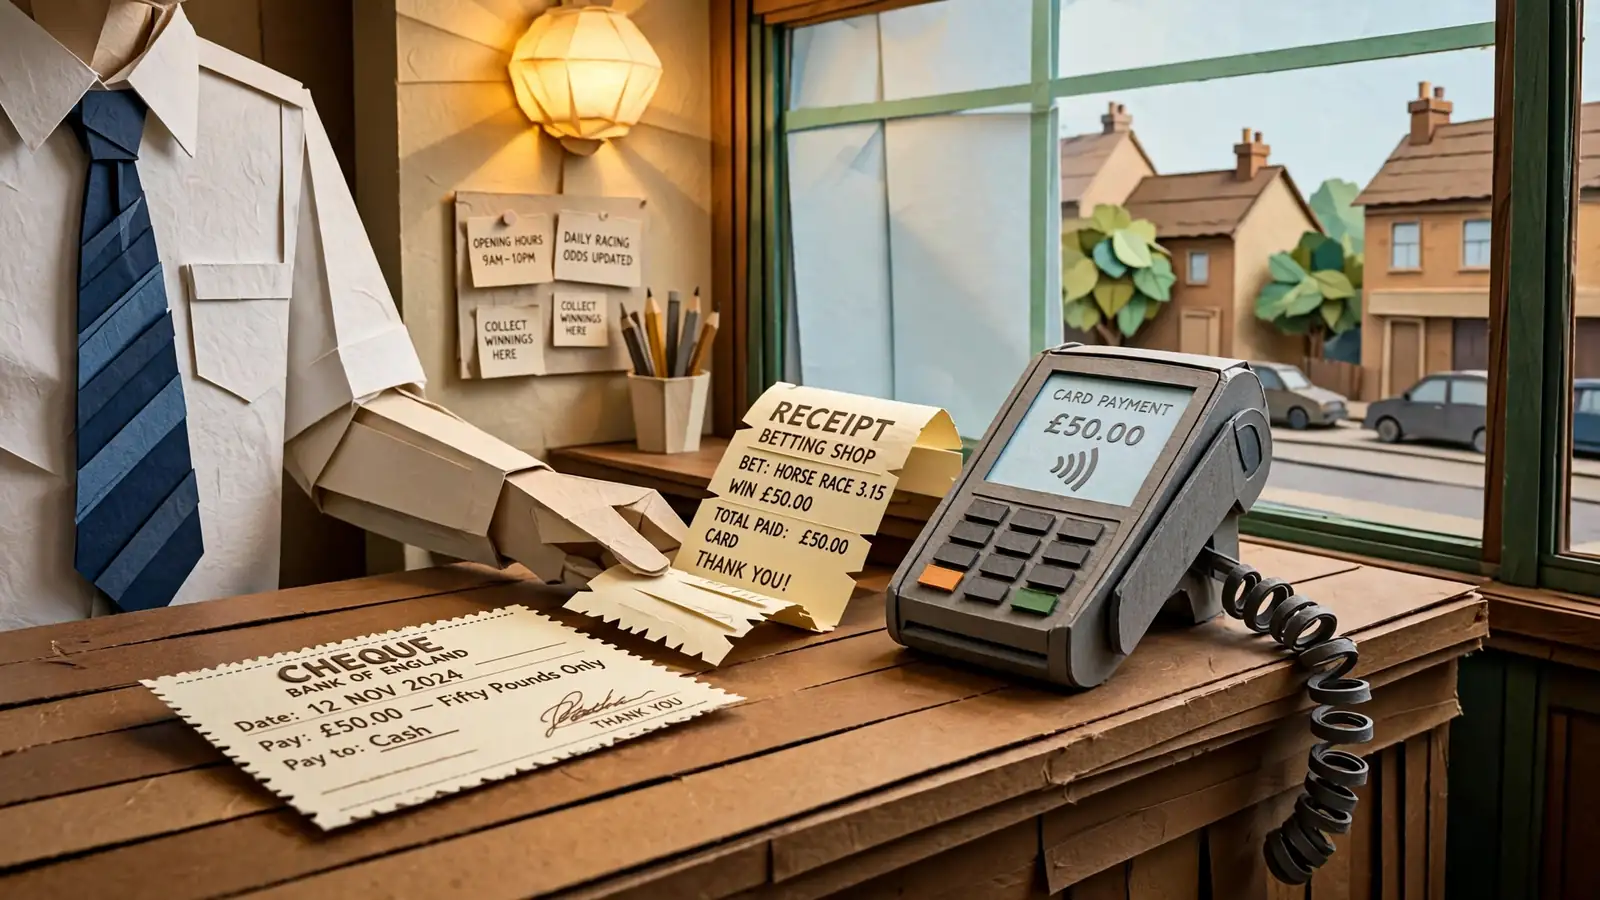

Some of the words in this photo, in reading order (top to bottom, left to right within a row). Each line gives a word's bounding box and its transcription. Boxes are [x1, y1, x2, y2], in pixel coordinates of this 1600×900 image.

[473, 236, 511, 249] OPENING
[514, 235, 543, 246] HOURS
[564, 231, 592, 246] DAILY
[595, 234, 630, 249] RACING
[563, 249, 588, 262] ODDS
[592, 252, 633, 266] UPDATED
[560, 301, 596, 312] COLLECT
[560, 313, 602, 323] WINNINGS
[484, 320, 527, 332] COLLECT
[484, 333, 534, 346] WINNINGS
[566, 325, 587, 336] HERE
[492, 348, 517, 360] HERE
[1053, 388, 1093, 405] CARD
[1097, 394, 1174, 417] PAYMENT
[769, 400, 896, 442] RECEIPT
[1044, 413, 1145, 446] £50.00
[758, 428, 827, 456] BETTING
[830, 443, 876, 465] SHOP
[738, 455, 770, 475] BET:
[774, 463, 817, 486] HORSE
[819, 472, 854, 494] RACE
[856, 481, 887, 501] 3.15
[728, 478, 757, 498] WIN
[760, 486, 813, 512] £50.00
[705, 528, 739, 549] CARD
[714, 506, 750, 530] TOTAL
[754, 517, 789, 539] PAID:
[799, 529, 849, 555] £50.00
[696, 550, 747, 580] THANK
[752, 565, 792, 592] YOU!
[277, 636, 444, 683] CHEQUE
[285, 678, 346, 698] BANK
[350, 670, 374, 682] OF
[380, 649, 468, 675] ENGLAND
[234, 712, 300, 733] Date:
[307, 700, 341, 714] 12
[344, 684, 397, 706] NOV
[402, 669, 464, 691] 2024
[258, 734, 311, 752] Pay:
[320, 707, 403, 738] £50.00
[436, 689, 489, 707] Fifty
[488, 671, 561, 694] Pounds
[560, 658, 606, 676] Only
[590, 710, 644, 730] THANK
[648, 697, 683, 713] YOU
[282, 754, 326, 771] Pay
[330, 744, 365, 758] to:
[369, 725, 432, 747] Cash
